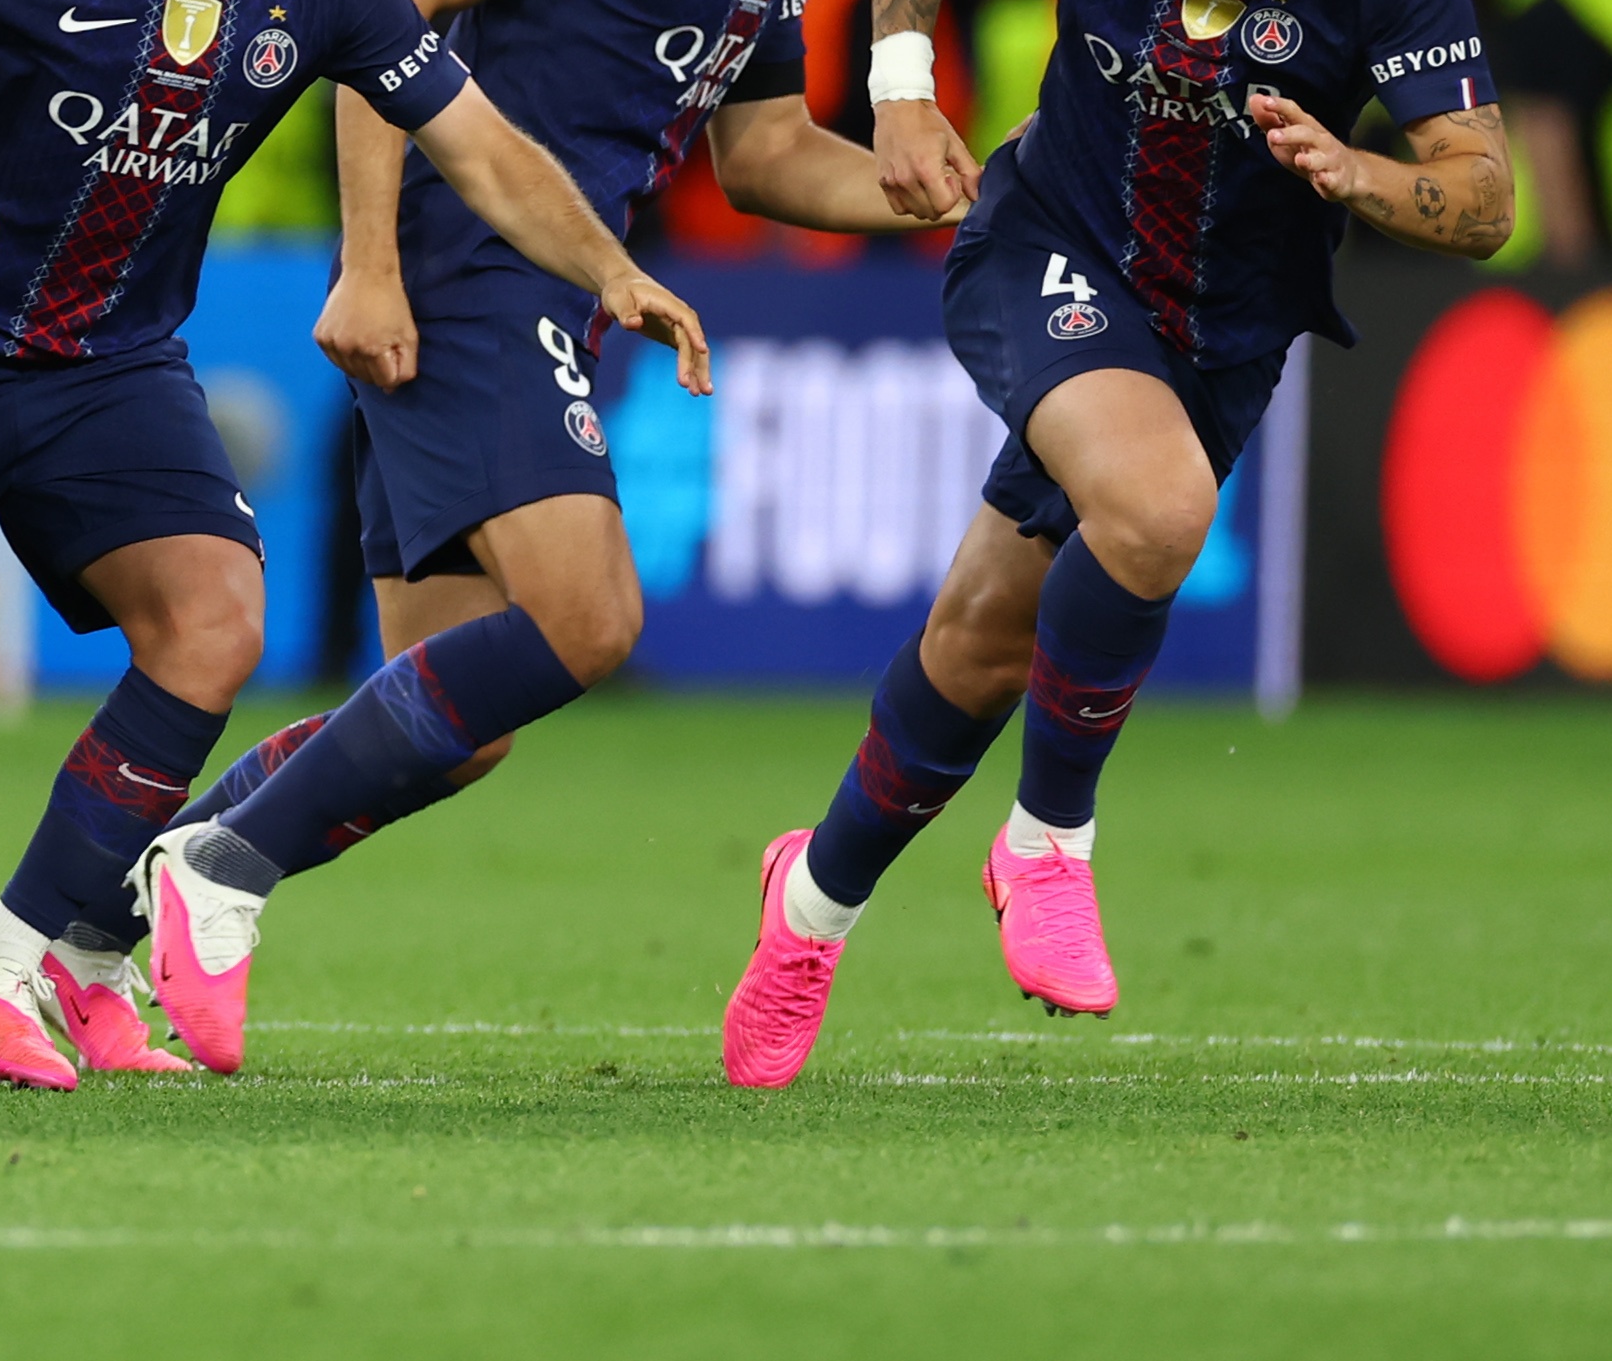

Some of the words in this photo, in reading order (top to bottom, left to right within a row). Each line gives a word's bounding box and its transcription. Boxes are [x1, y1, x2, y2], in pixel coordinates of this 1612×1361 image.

[256, 31, 291, 49] PARIS
[1253, 10, 1294, 27] PARIS
[1370, 36, 1482, 84] BEYOND
[48, 90, 250, 160] QATAR
[1041, 252, 1099, 302] 4
